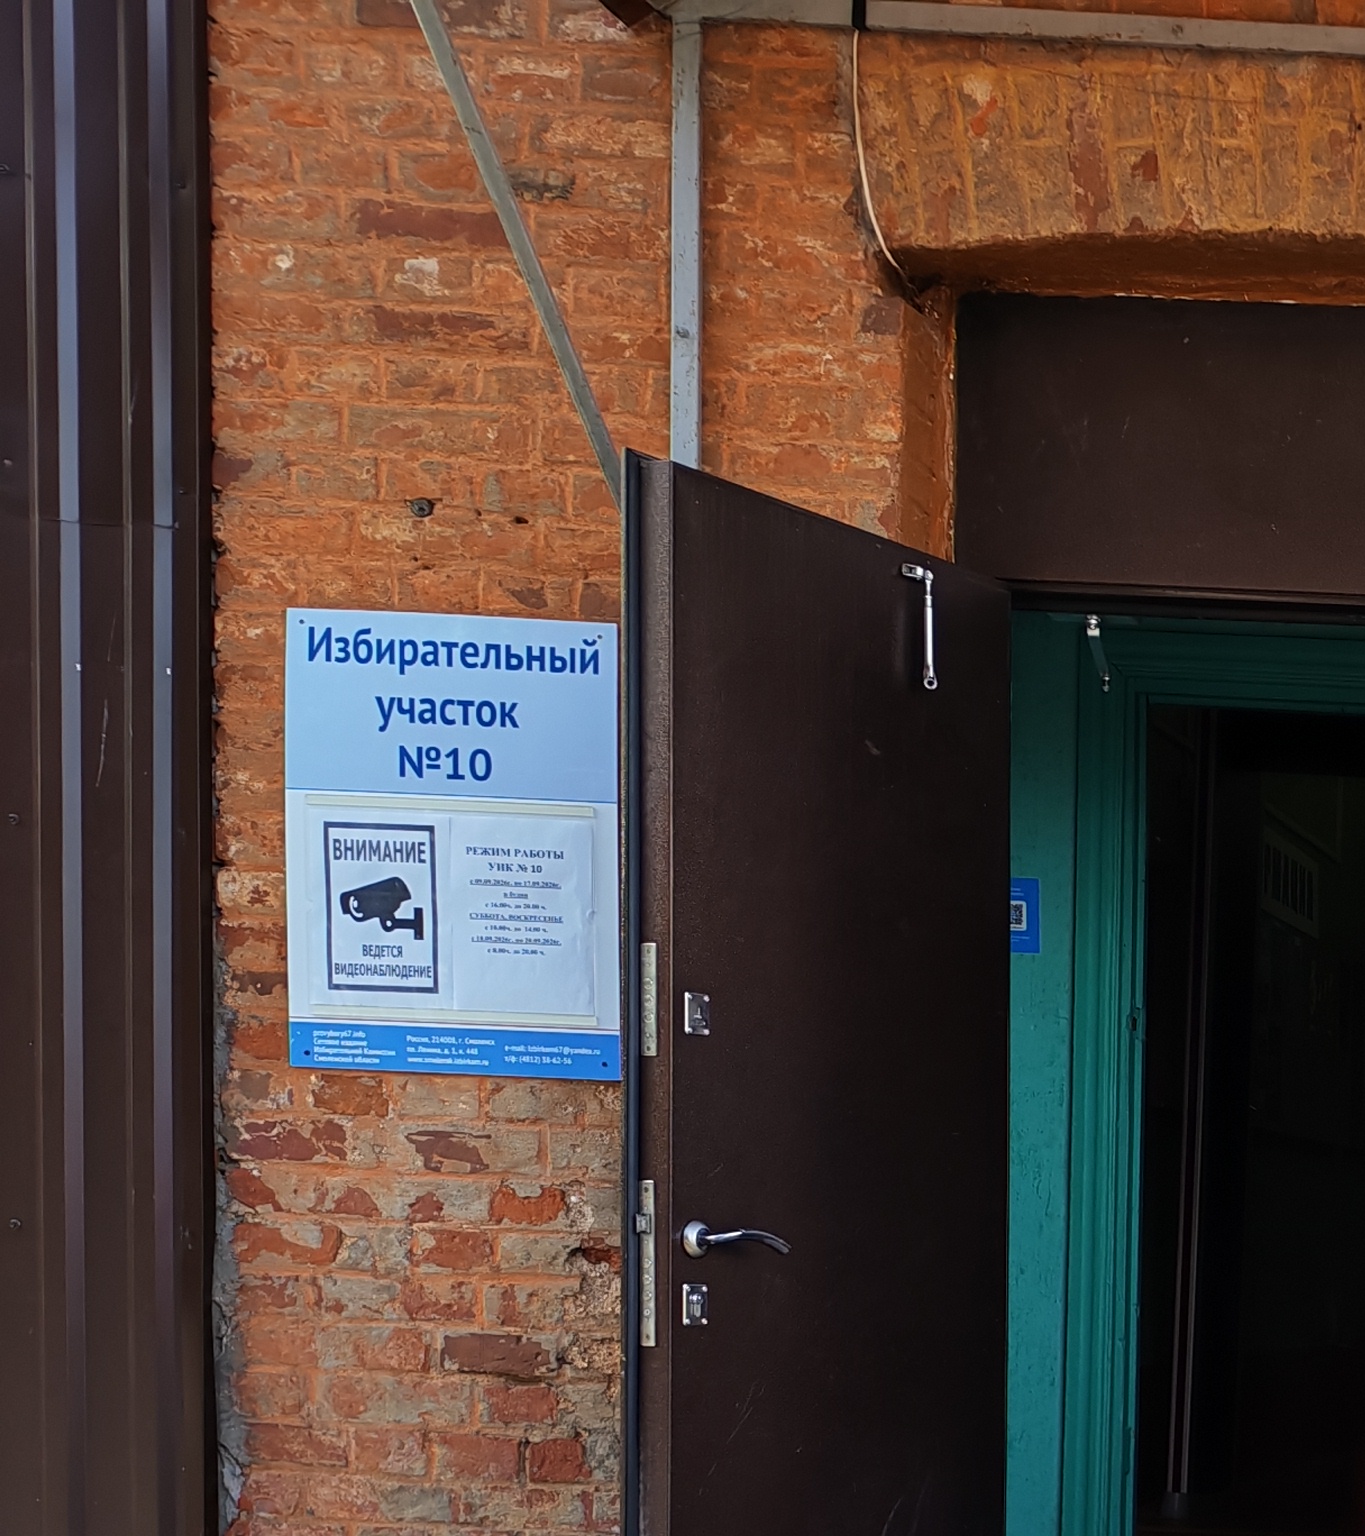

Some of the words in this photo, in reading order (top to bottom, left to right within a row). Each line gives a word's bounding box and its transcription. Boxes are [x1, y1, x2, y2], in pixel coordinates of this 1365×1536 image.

[307, 626, 600, 675] Избирательный
[375, 696, 520, 732] участок
[398, 745, 493, 781] №10
[333, 838, 427, 864] ВНИМАНИЕ
[465, 846, 511, 857] РЕЖИМ
[514, 848, 564, 860] РАБОТЫ
[488, 862, 514, 872] УИК
[531, 865, 543, 873] 10
[362, 943, 403, 960] ВЕДЕТСЯ
[334, 962, 432, 980] ВИДЕОНАБЛЮДЕНИЕ
